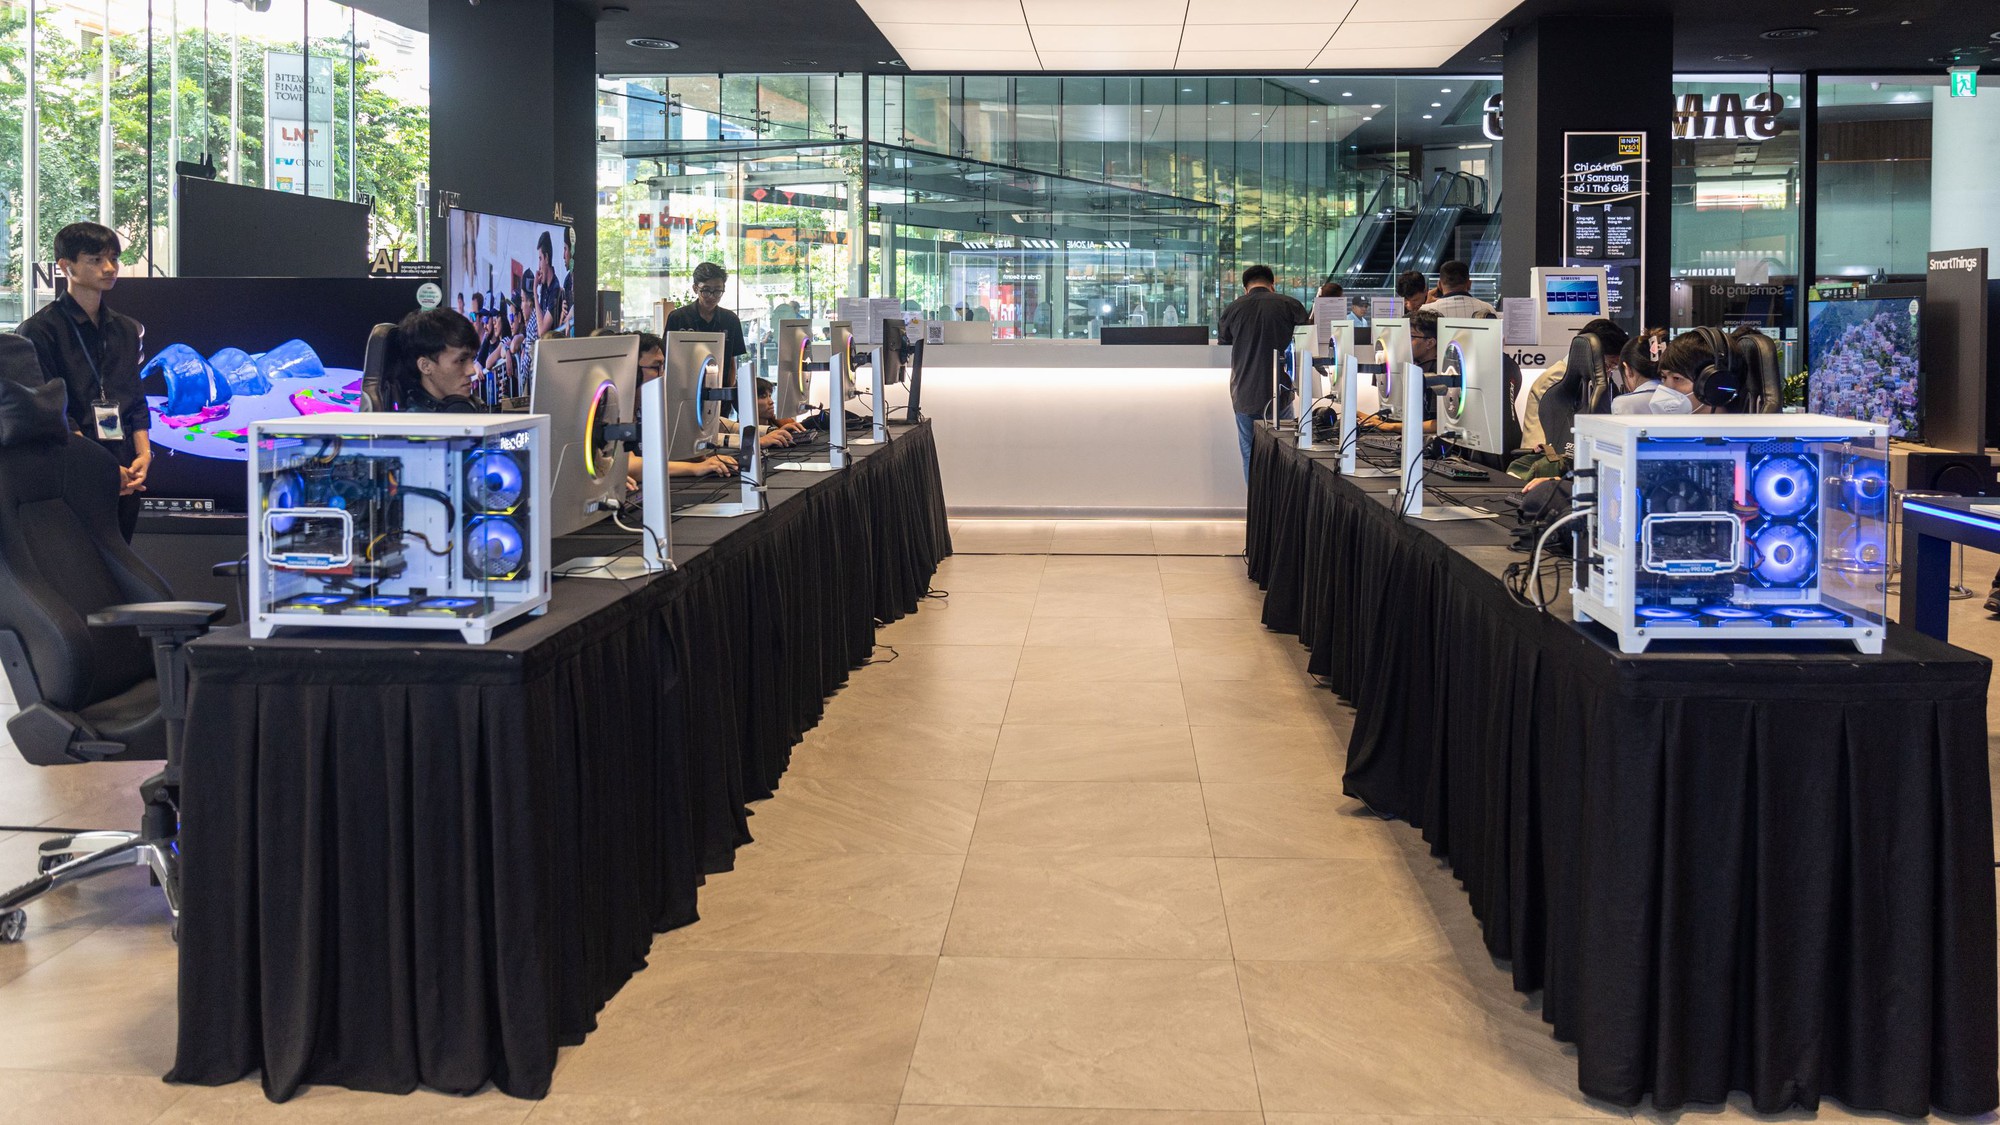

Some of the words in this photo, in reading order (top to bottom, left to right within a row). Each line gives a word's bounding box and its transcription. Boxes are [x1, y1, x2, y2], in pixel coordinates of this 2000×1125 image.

[275, 92, 304, 102] TOWE
[1573, 162, 1589, 172] Chỉ
[1589, 162, 1602, 172] có
[1603, 163, 1622, 172] trên
[1574, 174, 1586, 182] TV
[1587, 173, 1629, 184] Samsung
[1573, 183, 1585, 193] số
[1592, 183, 1610, 193] Thế
[1611, 183, 1629, 193] Giới
[371, 248, 400, 273] AI
[1929, 256, 1977, 272] SmartThings
[32, 262, 61, 288] NE
